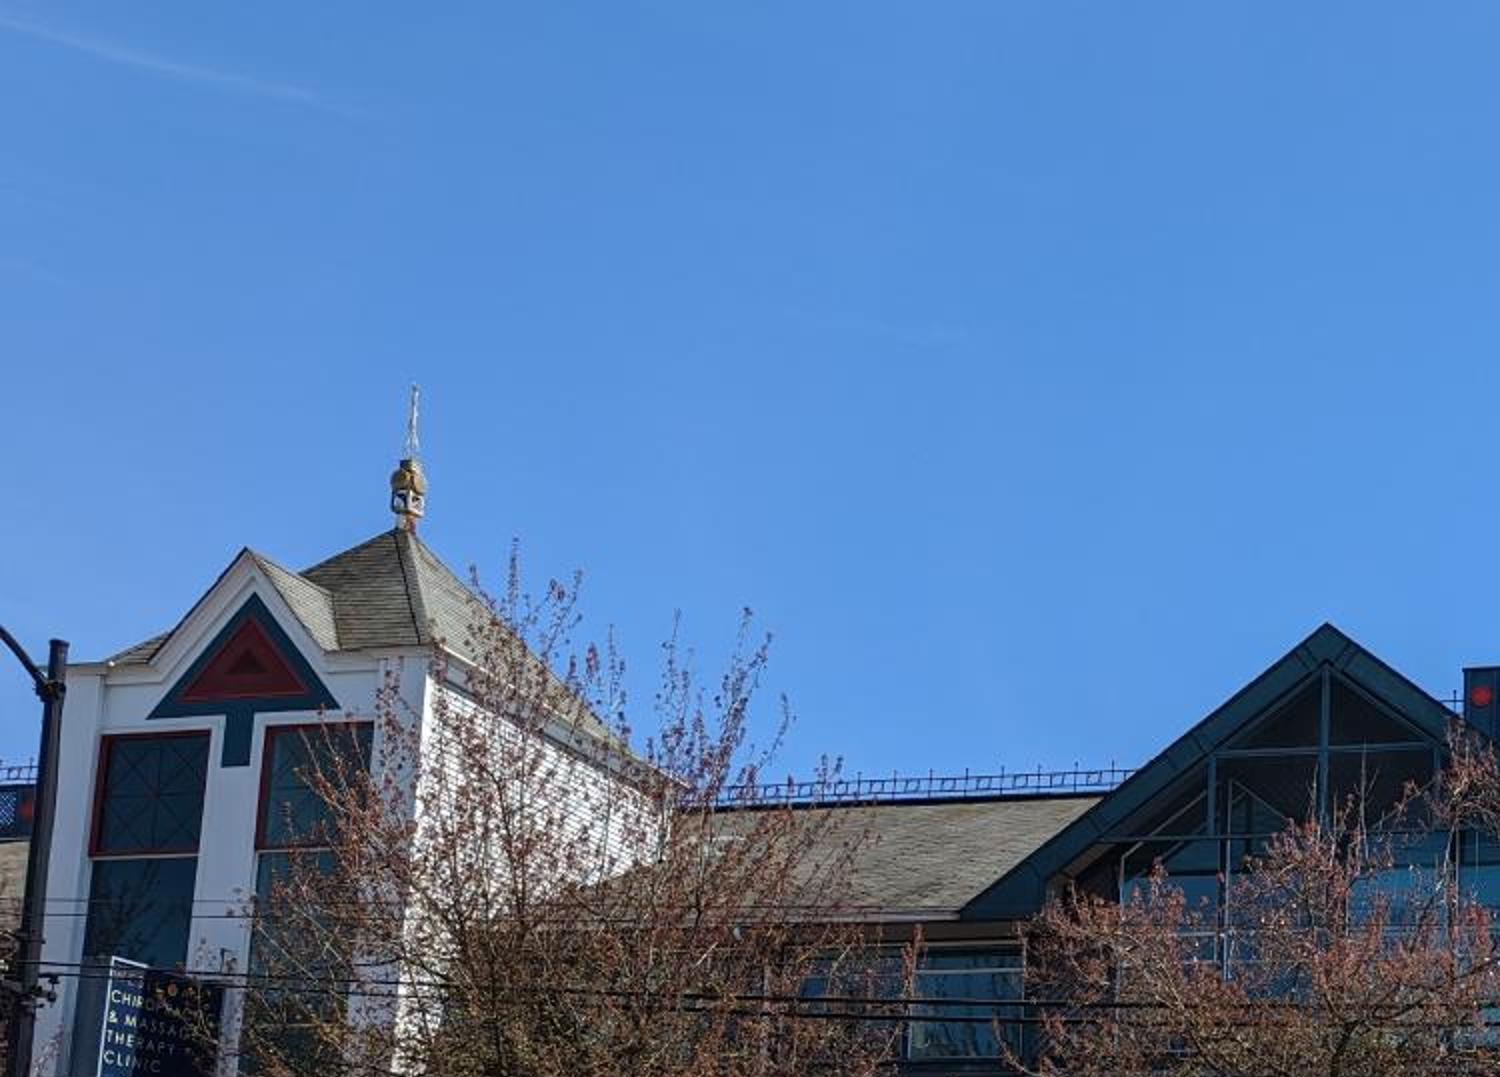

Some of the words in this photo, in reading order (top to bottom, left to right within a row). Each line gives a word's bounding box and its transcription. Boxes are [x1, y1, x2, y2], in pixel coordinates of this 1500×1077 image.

[125, 1014, 198, 1042] MASSAG
[105, 1029, 175, 1055] THERAPY
[103, 1050, 161, 1073] CLINIC
